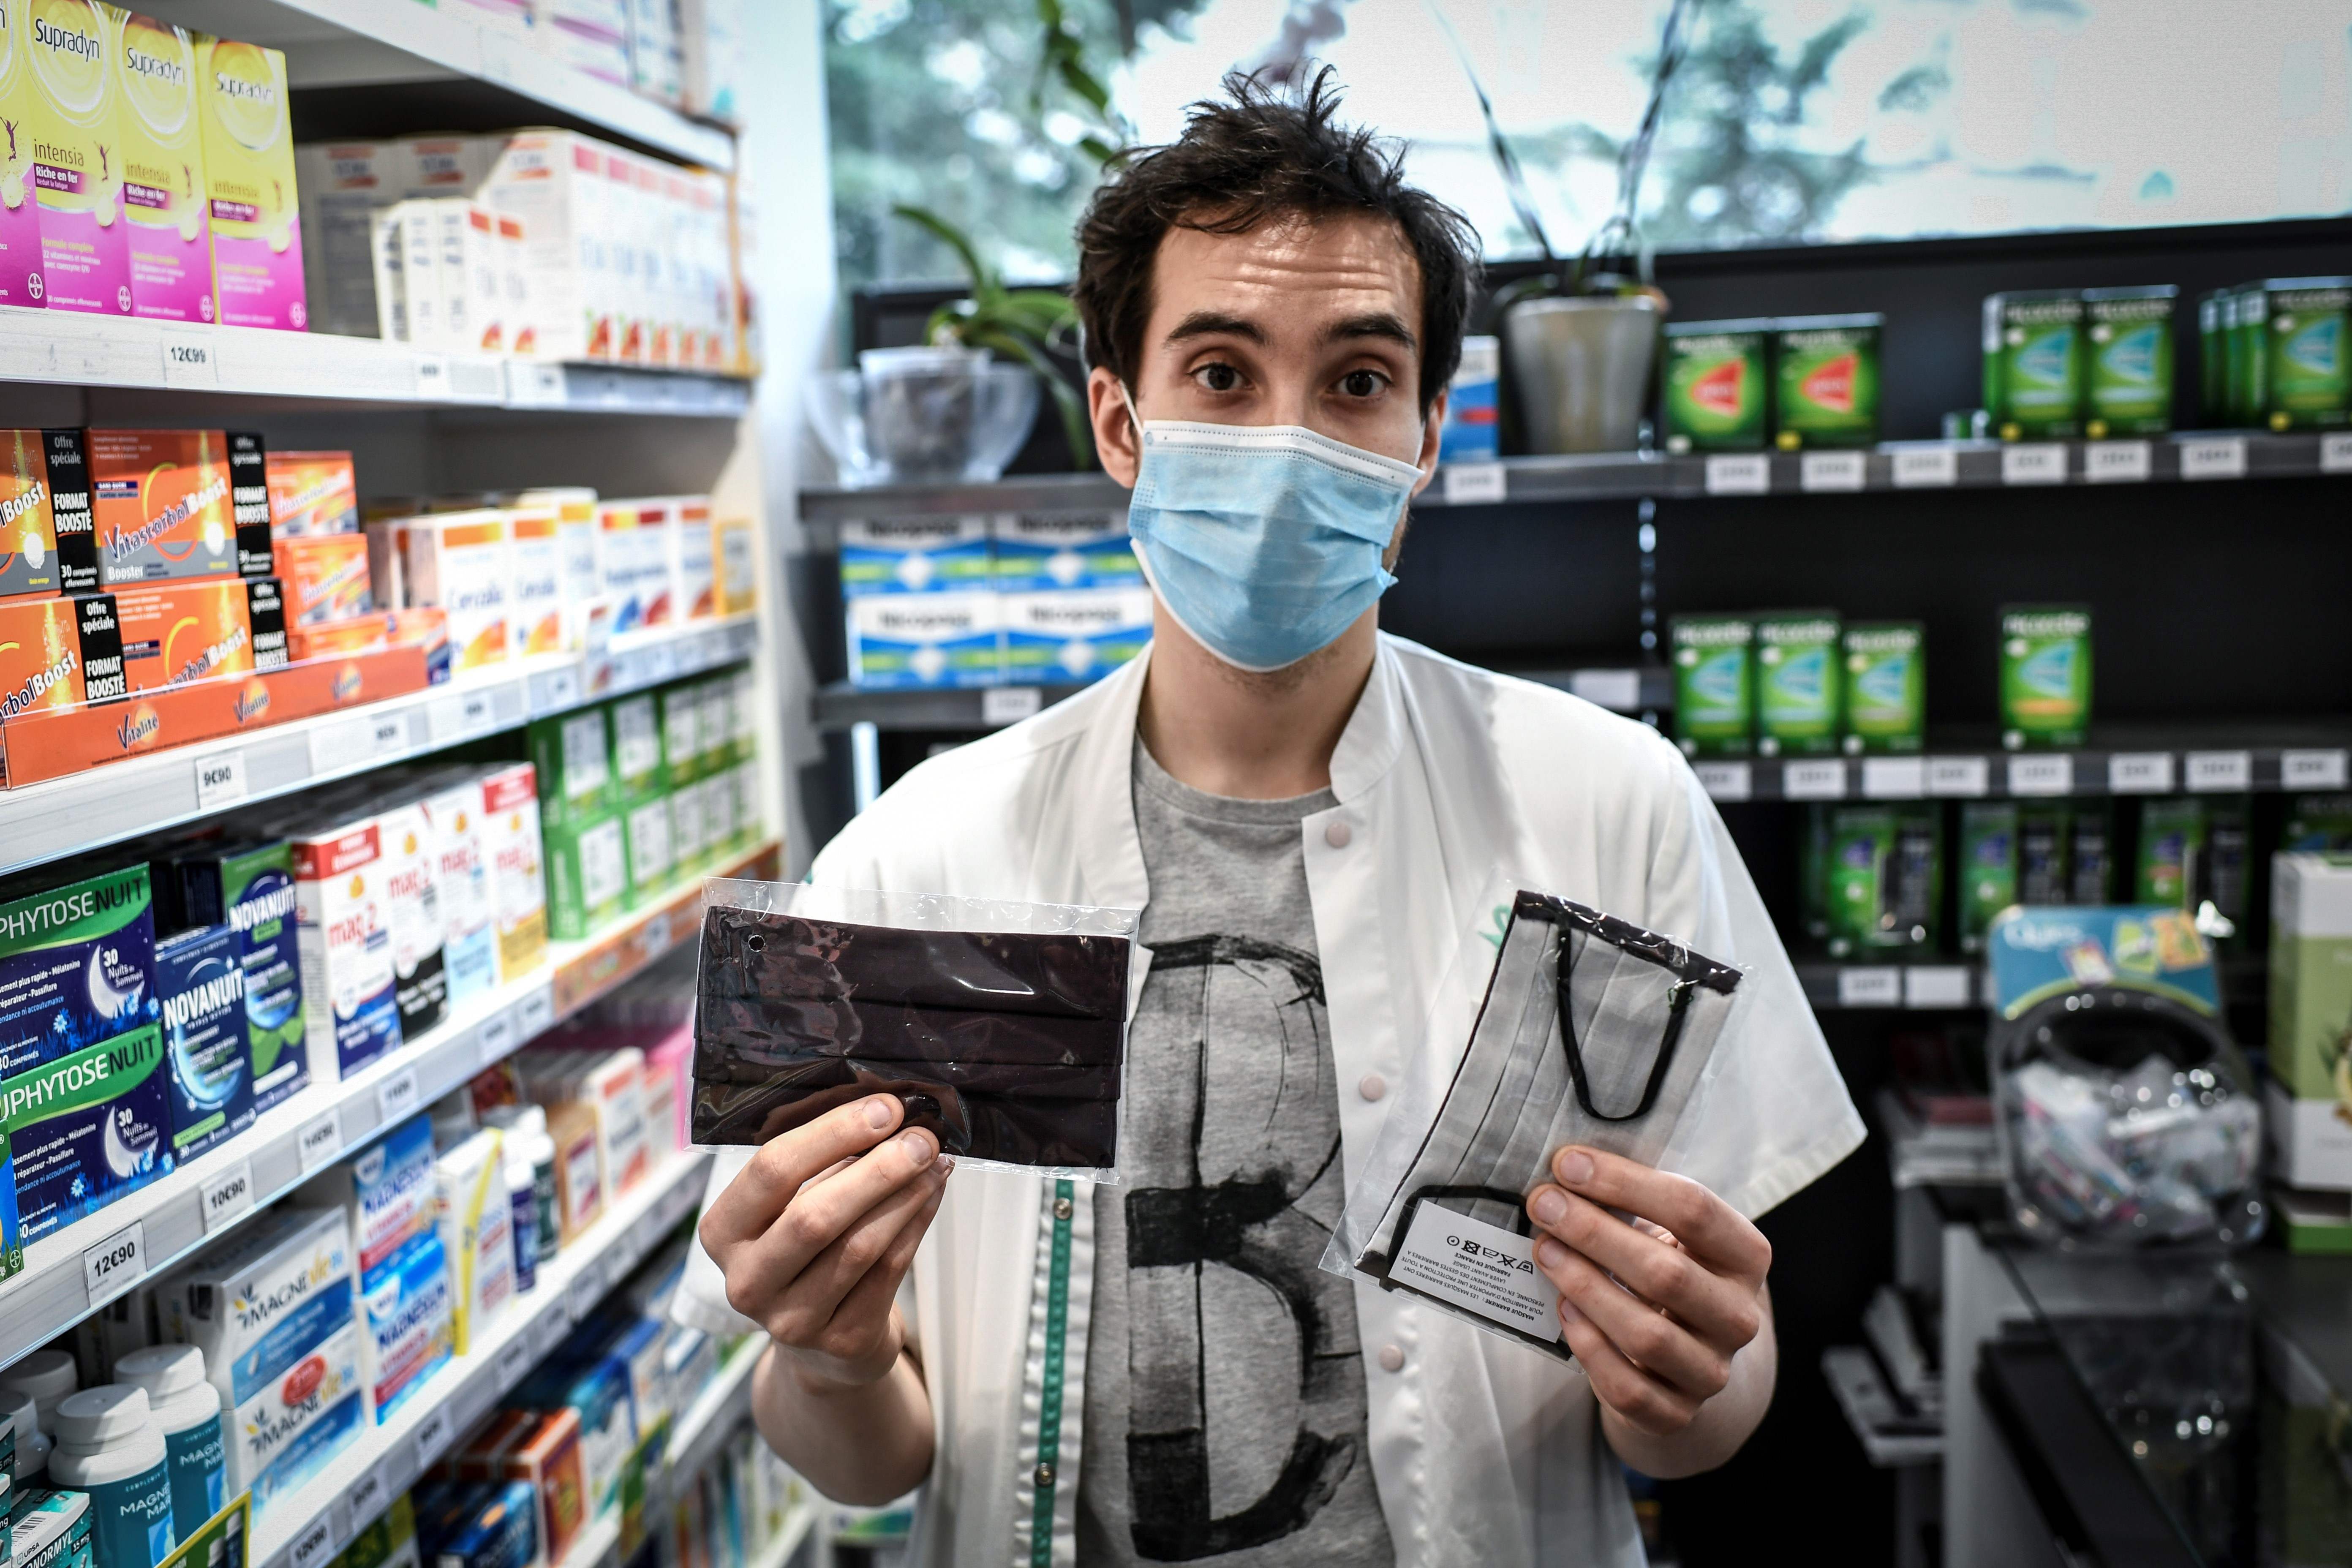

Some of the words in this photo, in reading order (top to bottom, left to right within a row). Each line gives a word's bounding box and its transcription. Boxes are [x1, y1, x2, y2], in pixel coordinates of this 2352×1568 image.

[35, 18, 100, 62] Supradyn
[127, 47, 185, 86] Supradyn
[34, 139, 84, 166] intensia
[36, 166, 56, 180] Riche
[57, 171, 67, 180] en
[68, 170, 78, 184] fer
[54, 436, 73, 449] Offre
[50, 451, 81, 467] spéciale
[54, 493, 88, 510] FORMAT
[55, 510, 92, 533] BOOSTÉ
[61, 565, 72, 578] 30
[107, 566, 143, 581] Booster
[86, 602, 106, 616] Offre
[82, 616, 115, 635] spéciale
[85, 655, 121, 678] FORMAT
[87, 674, 125, 700] BOOSTÉ
[117, 713, 160, 751] Vitalité
[229, 884, 296, 933] NOVANUIT
[103, 948, 119, 967] 30
[19, 977, 30, 989] plus
[31, 970, 48, 985] rapide
[52, 960, 80, 976] Mélatonine
[107, 964, 128, 980] Nuits
[31, 983, 57, 998] Passiflore
[163, 967, 243, 1031] NOVANUIT
[22, 1007, 27, 1015] ni
[28, 995, 64, 1013] accoutumance
[10, 1049, 39, 1067] COMPRIMÉS
[117, 1107, 133, 1127] 30
[36, 1145, 49, 1157] plus
[49, 1136, 65, 1152] rapide
[68, 1123, 96, 1141] Mélatonine
[17, 1160, 45, 1180] réparateur
[46, 1160, 81, 1182] accoutumance
[29, 1216, 58, 1236] COMPRIMÉS
[95, 1241, 135, 1277] 12€90
[1401, 1256, 1418, 1267] TOUTE
[1411, 1252, 1439, 1267] BARRIERES
[1452, 1260, 1470, 1270] USAGE
[1454, 1252, 1475, 1264] FRANCE
[1423, 1265, 1456, 1282] PROTECTION
[1440, 1263, 1459, 1274] GESTES
[1470, 1267, 1489, 1277] AVANT
[1484, 1263, 1511, 1277] FABRIQUE
[1415, 1270, 1443, 1285] BARRIERES
[1456, 1278, 1468, 1287] UNE
[1469, 1276, 1507, 1293] COMPLEMENT
[1489, 1274, 1506, 1284] LAVER
[1443, 1282, 1469, 1296] MASQUES
[1469, 1283, 1501, 1299] D'APPORTER
[1484, 1298, 1511, 1312] BARRIERE
[1501, 1296, 1528, 1309] AMBITION
[1528, 1306, 1544, 1315] POUR
[1510, 1308, 1534, 1321] MASQUE
[24, 1542, 40, 1557] UPSA
[73, 1539, 80, 1552] 15
[81, 1532, 90, 1546] mg
